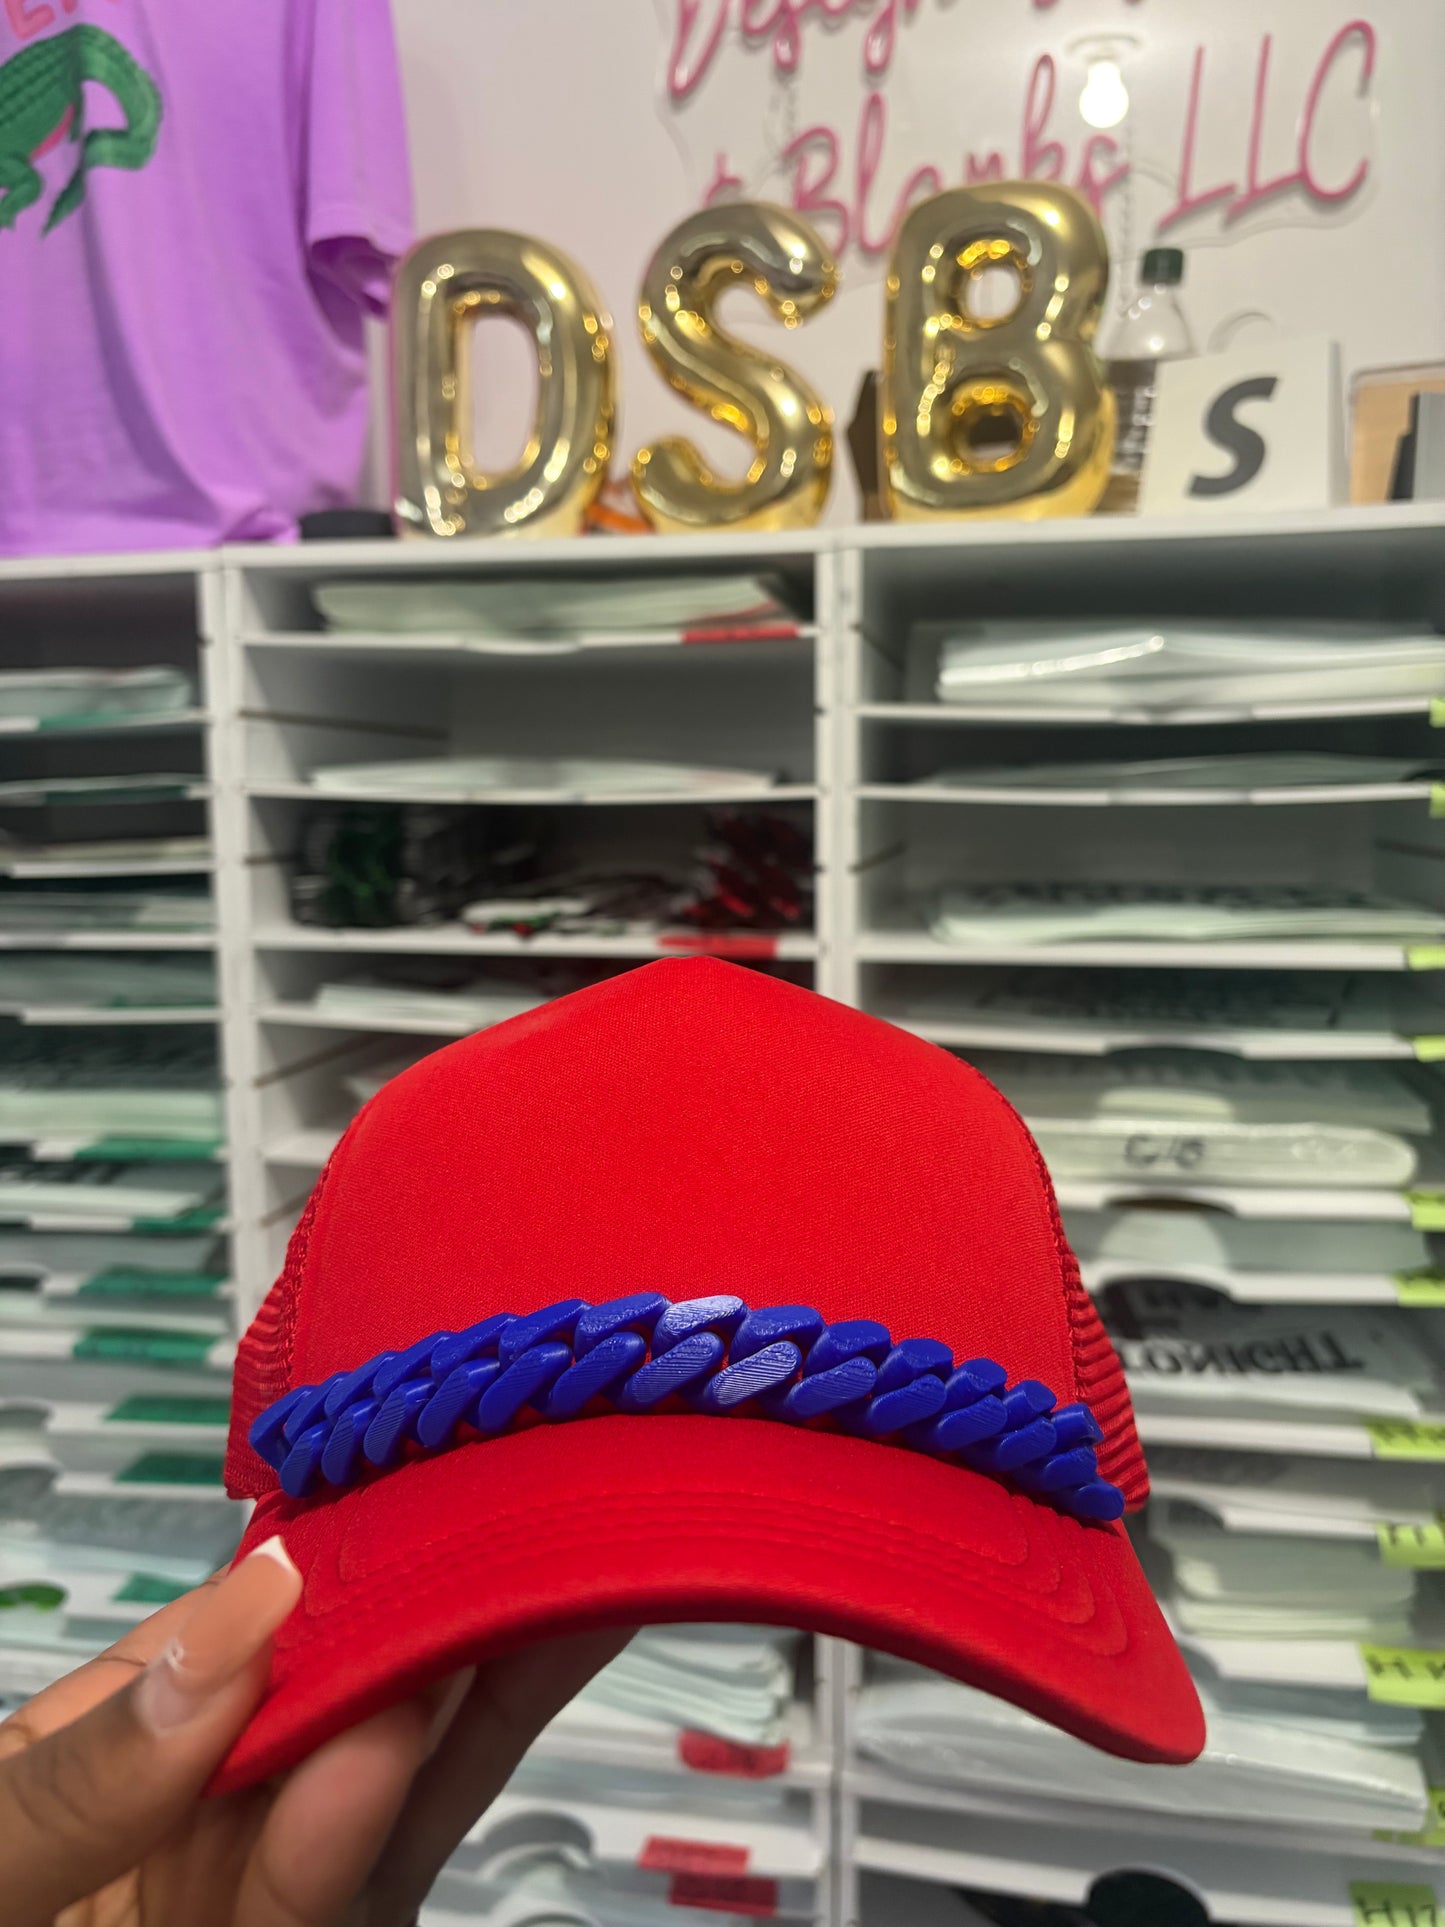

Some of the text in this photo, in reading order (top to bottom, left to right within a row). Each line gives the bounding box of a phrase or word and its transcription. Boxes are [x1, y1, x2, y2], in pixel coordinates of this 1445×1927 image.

[1157, 18, 1376, 229] LLC
[394, 180, 1117, 534] DSB
[1188, 376, 1278, 498] S
